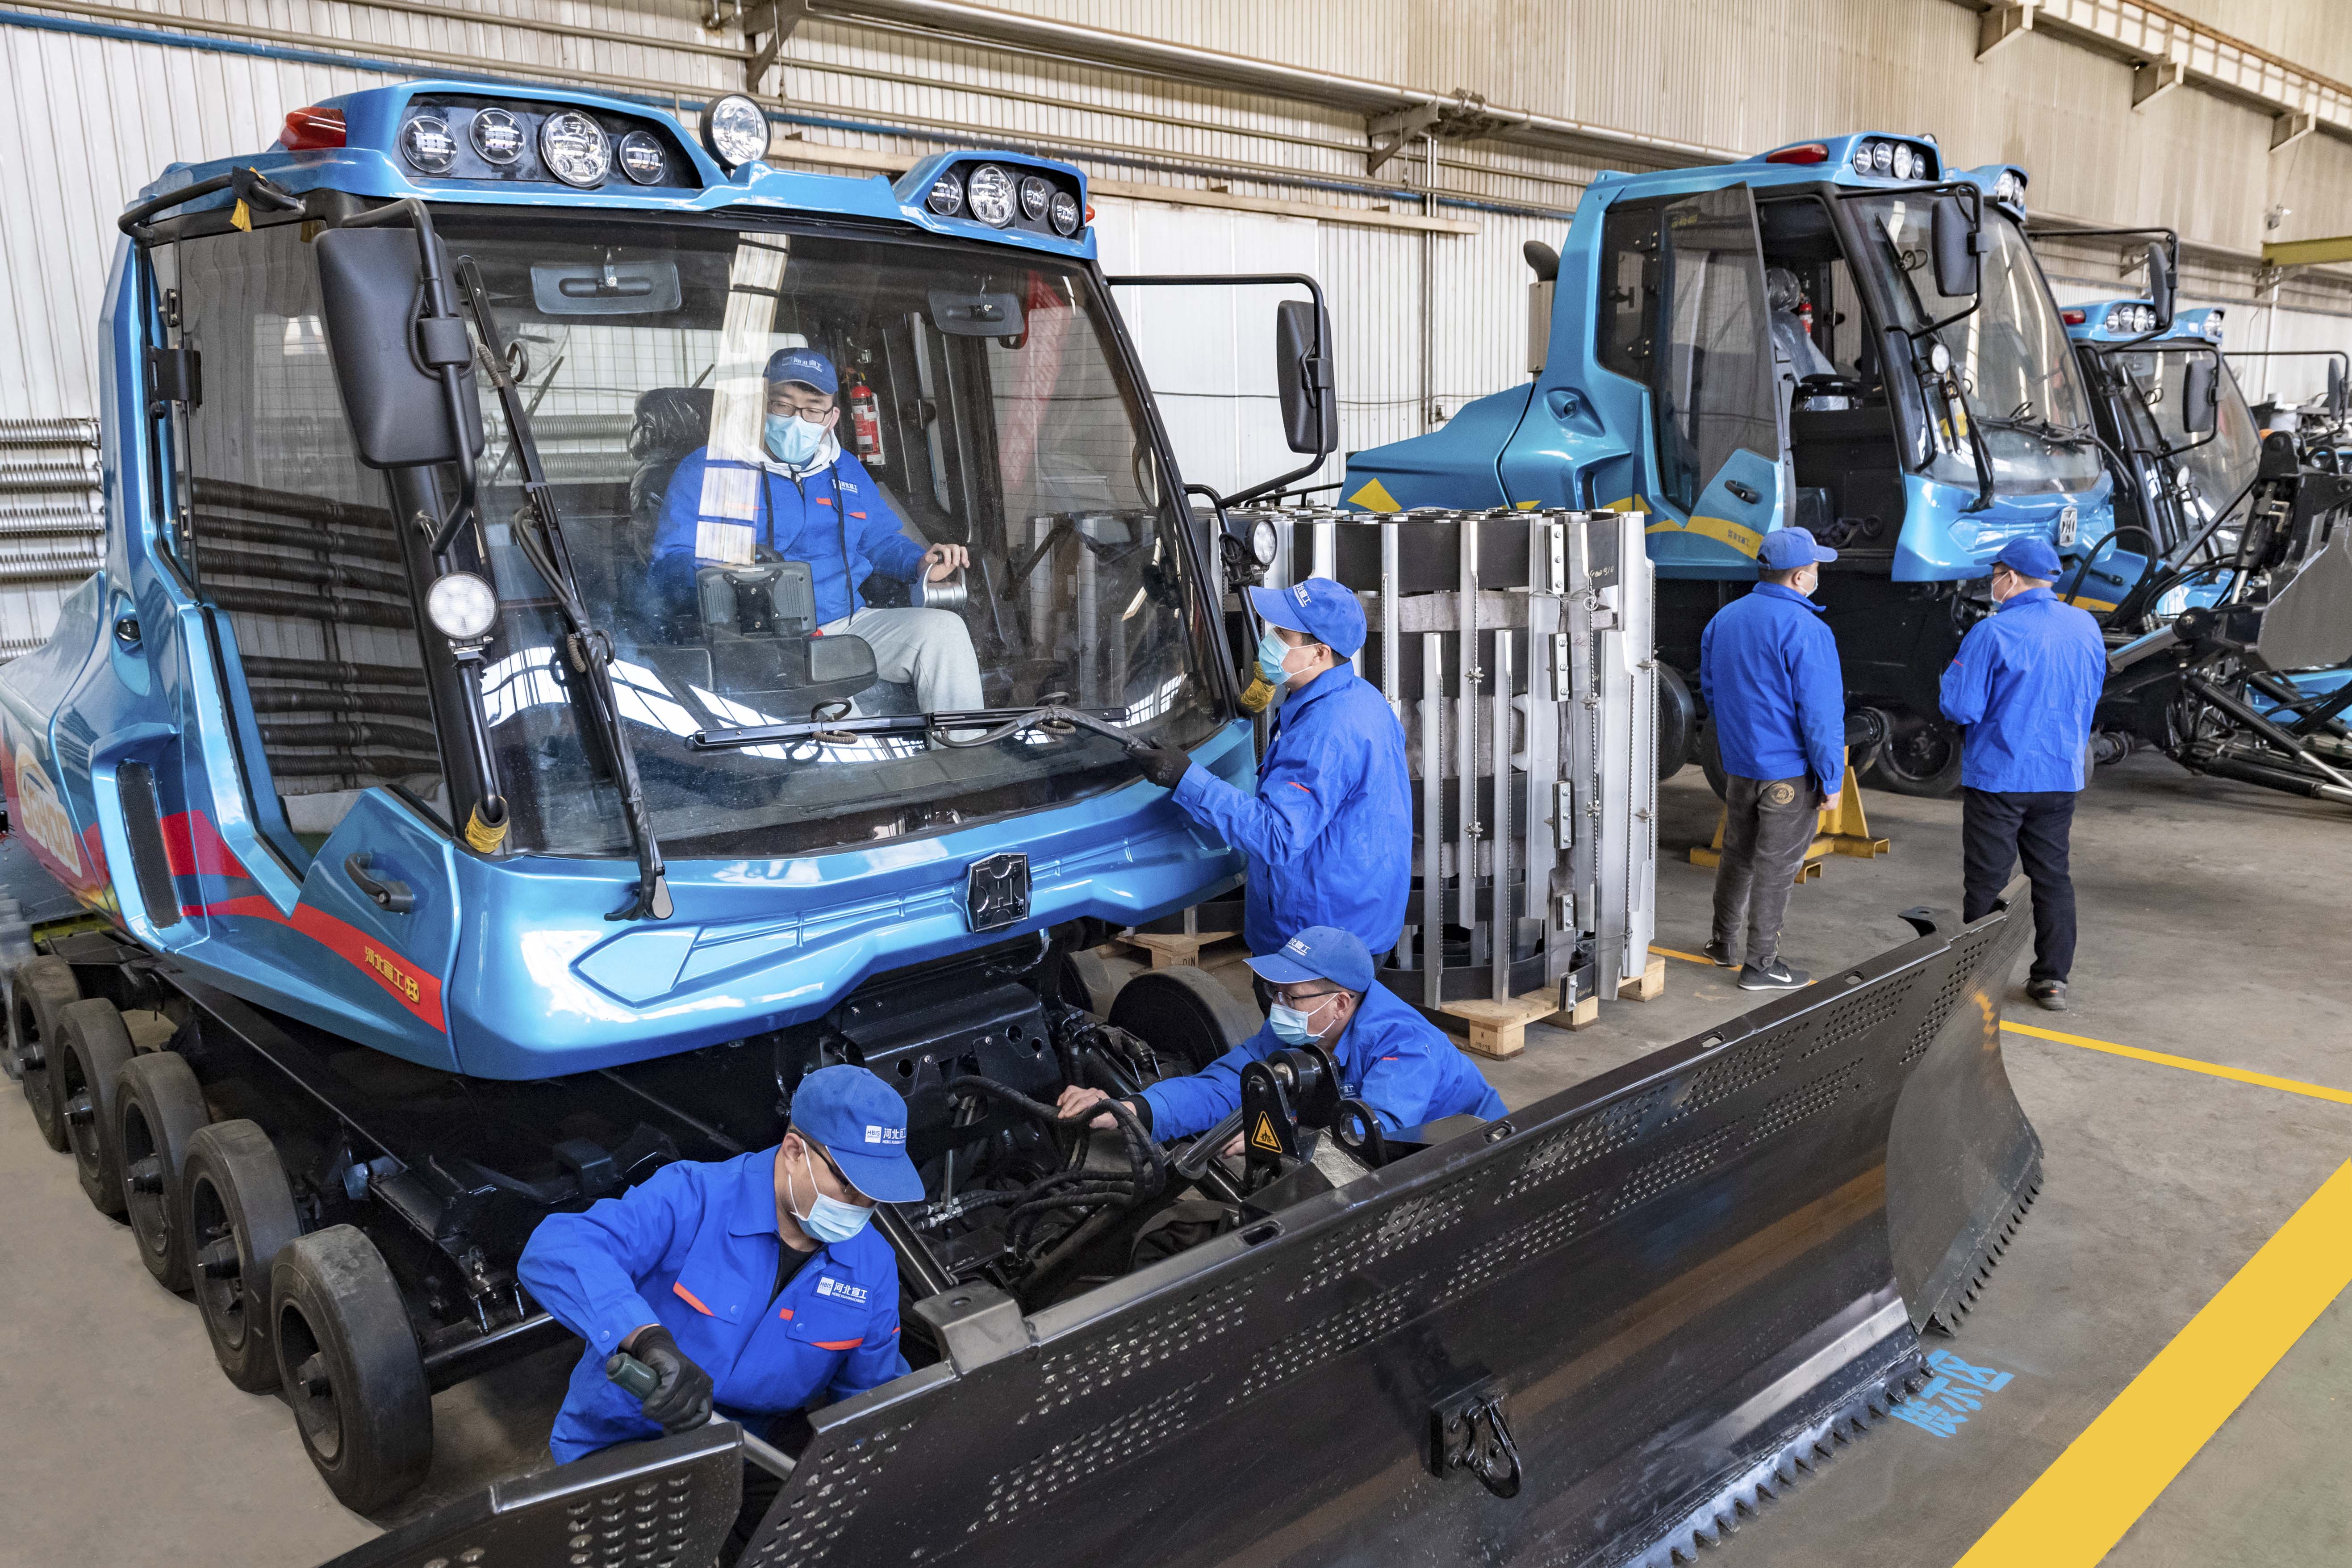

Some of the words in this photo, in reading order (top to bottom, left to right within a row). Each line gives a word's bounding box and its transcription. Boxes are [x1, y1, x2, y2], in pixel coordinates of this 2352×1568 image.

[365, 946, 404, 991] 河北宣工
[834, 1282, 868, 1300] 河北宣工
